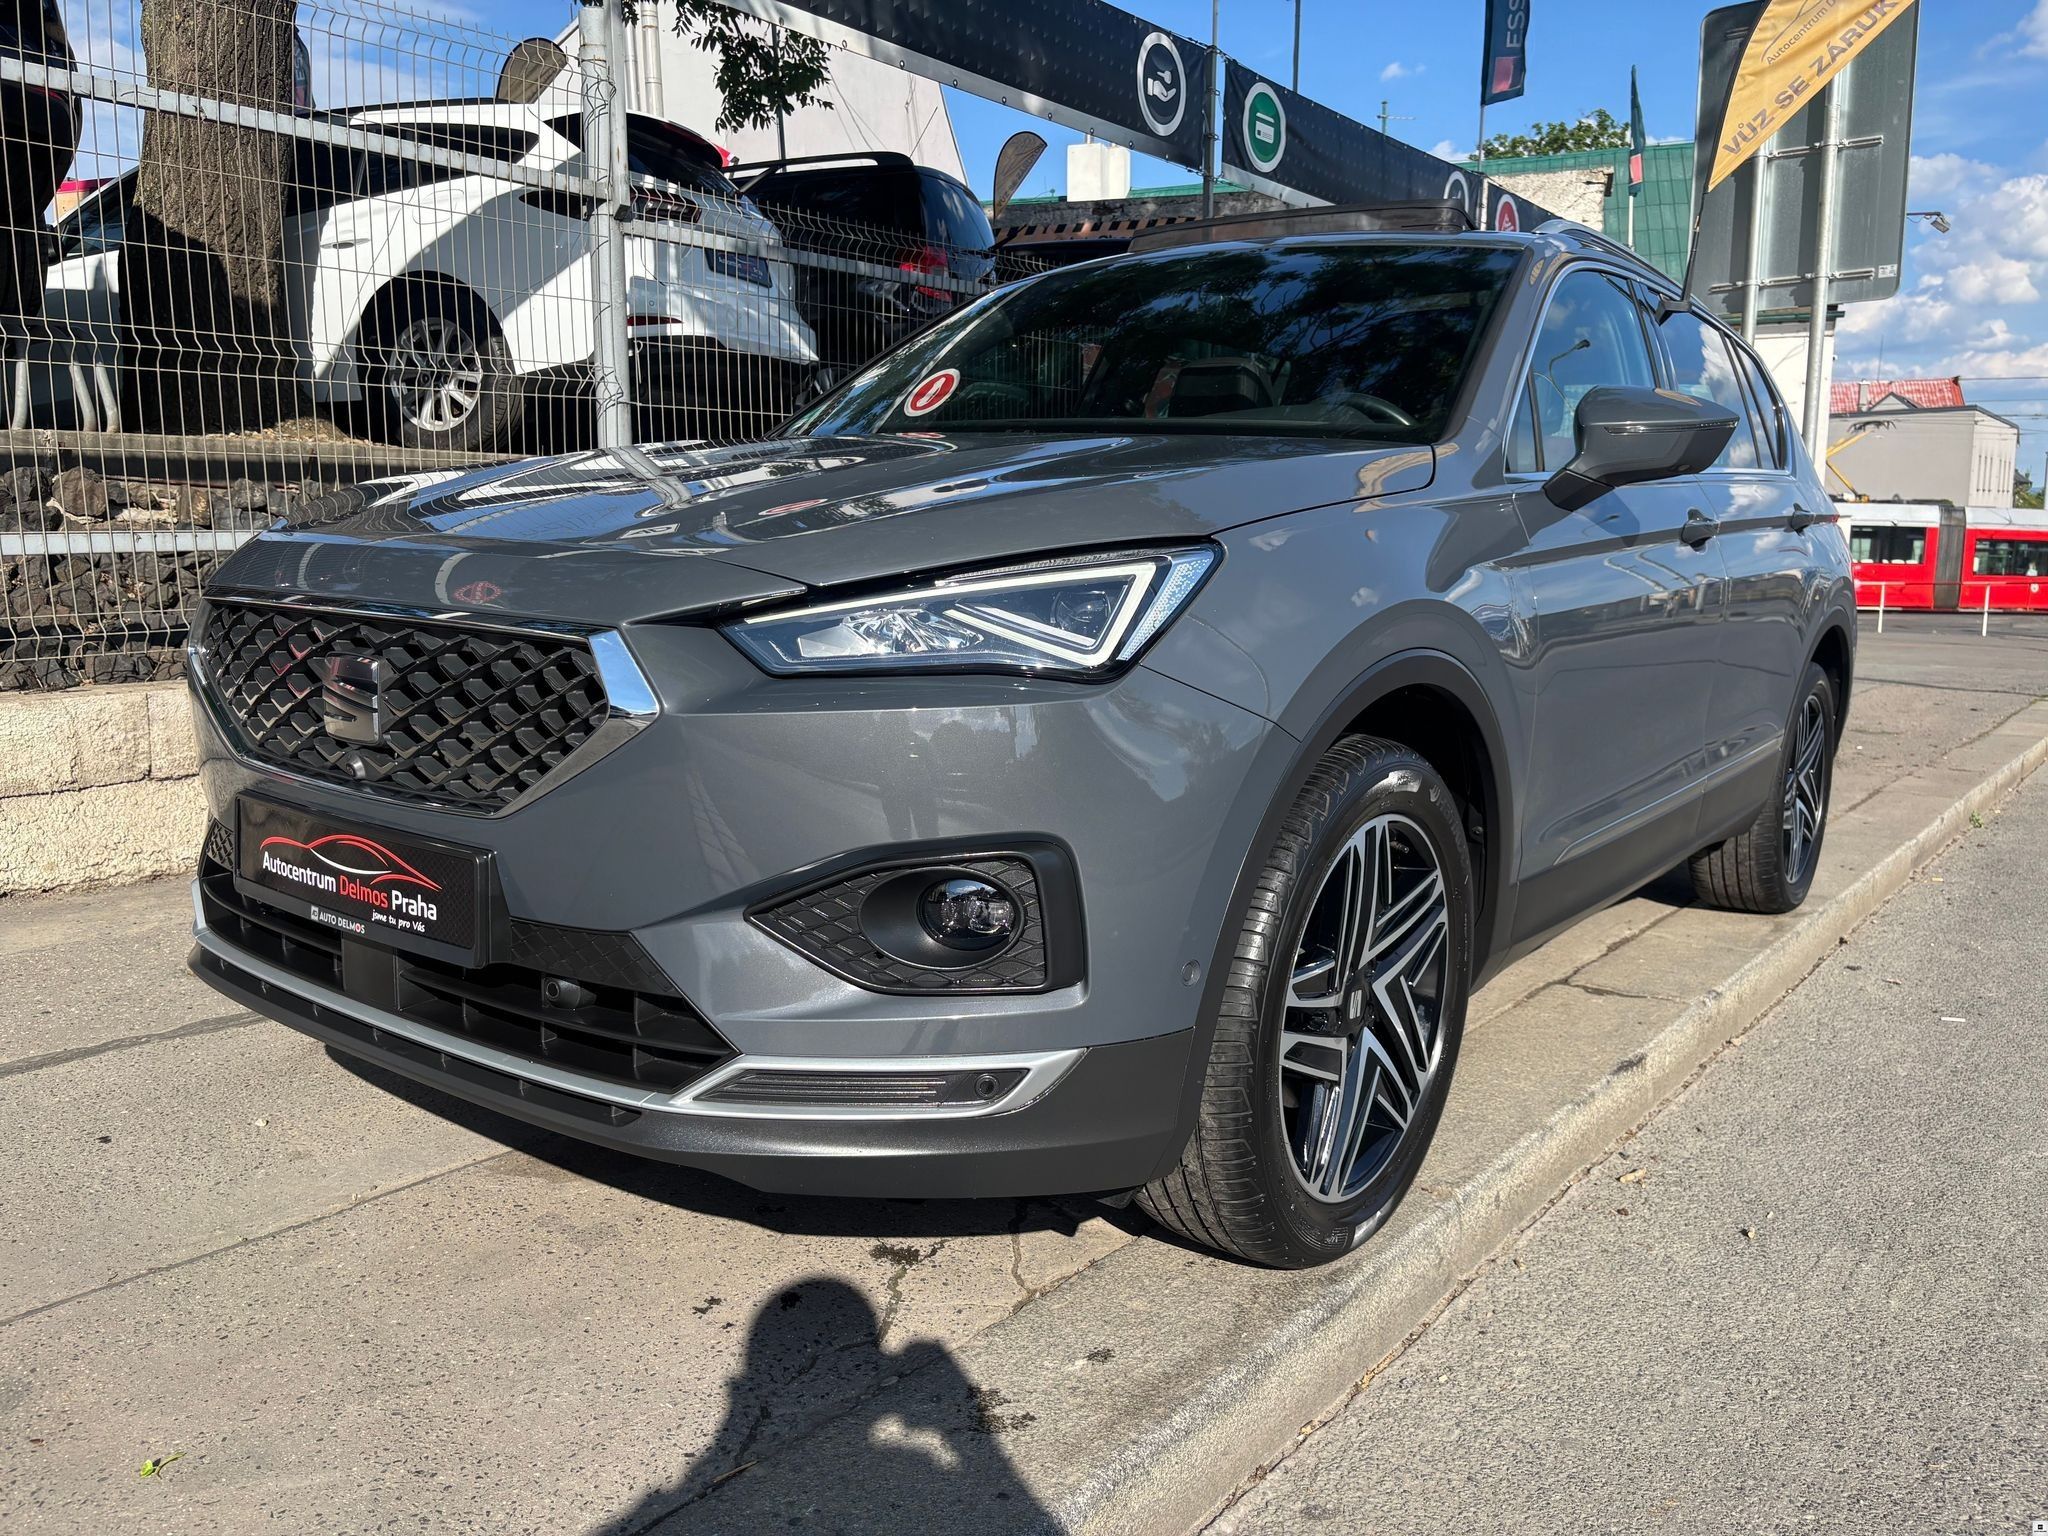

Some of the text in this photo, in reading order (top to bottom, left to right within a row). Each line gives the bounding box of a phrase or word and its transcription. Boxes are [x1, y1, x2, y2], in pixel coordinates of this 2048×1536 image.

[1766, 7, 1828, 65] Autocentrum
[1722, 0, 1901, 155] VŮZ SE ZÁRUK
[263, 851, 437, 921] Autocentrum Delmos Praha
[319, 911, 337, 925] AUTO
[337, 917, 366, 934] DELMOS
[372, 909, 426, 933] jsme tu pro Vás
